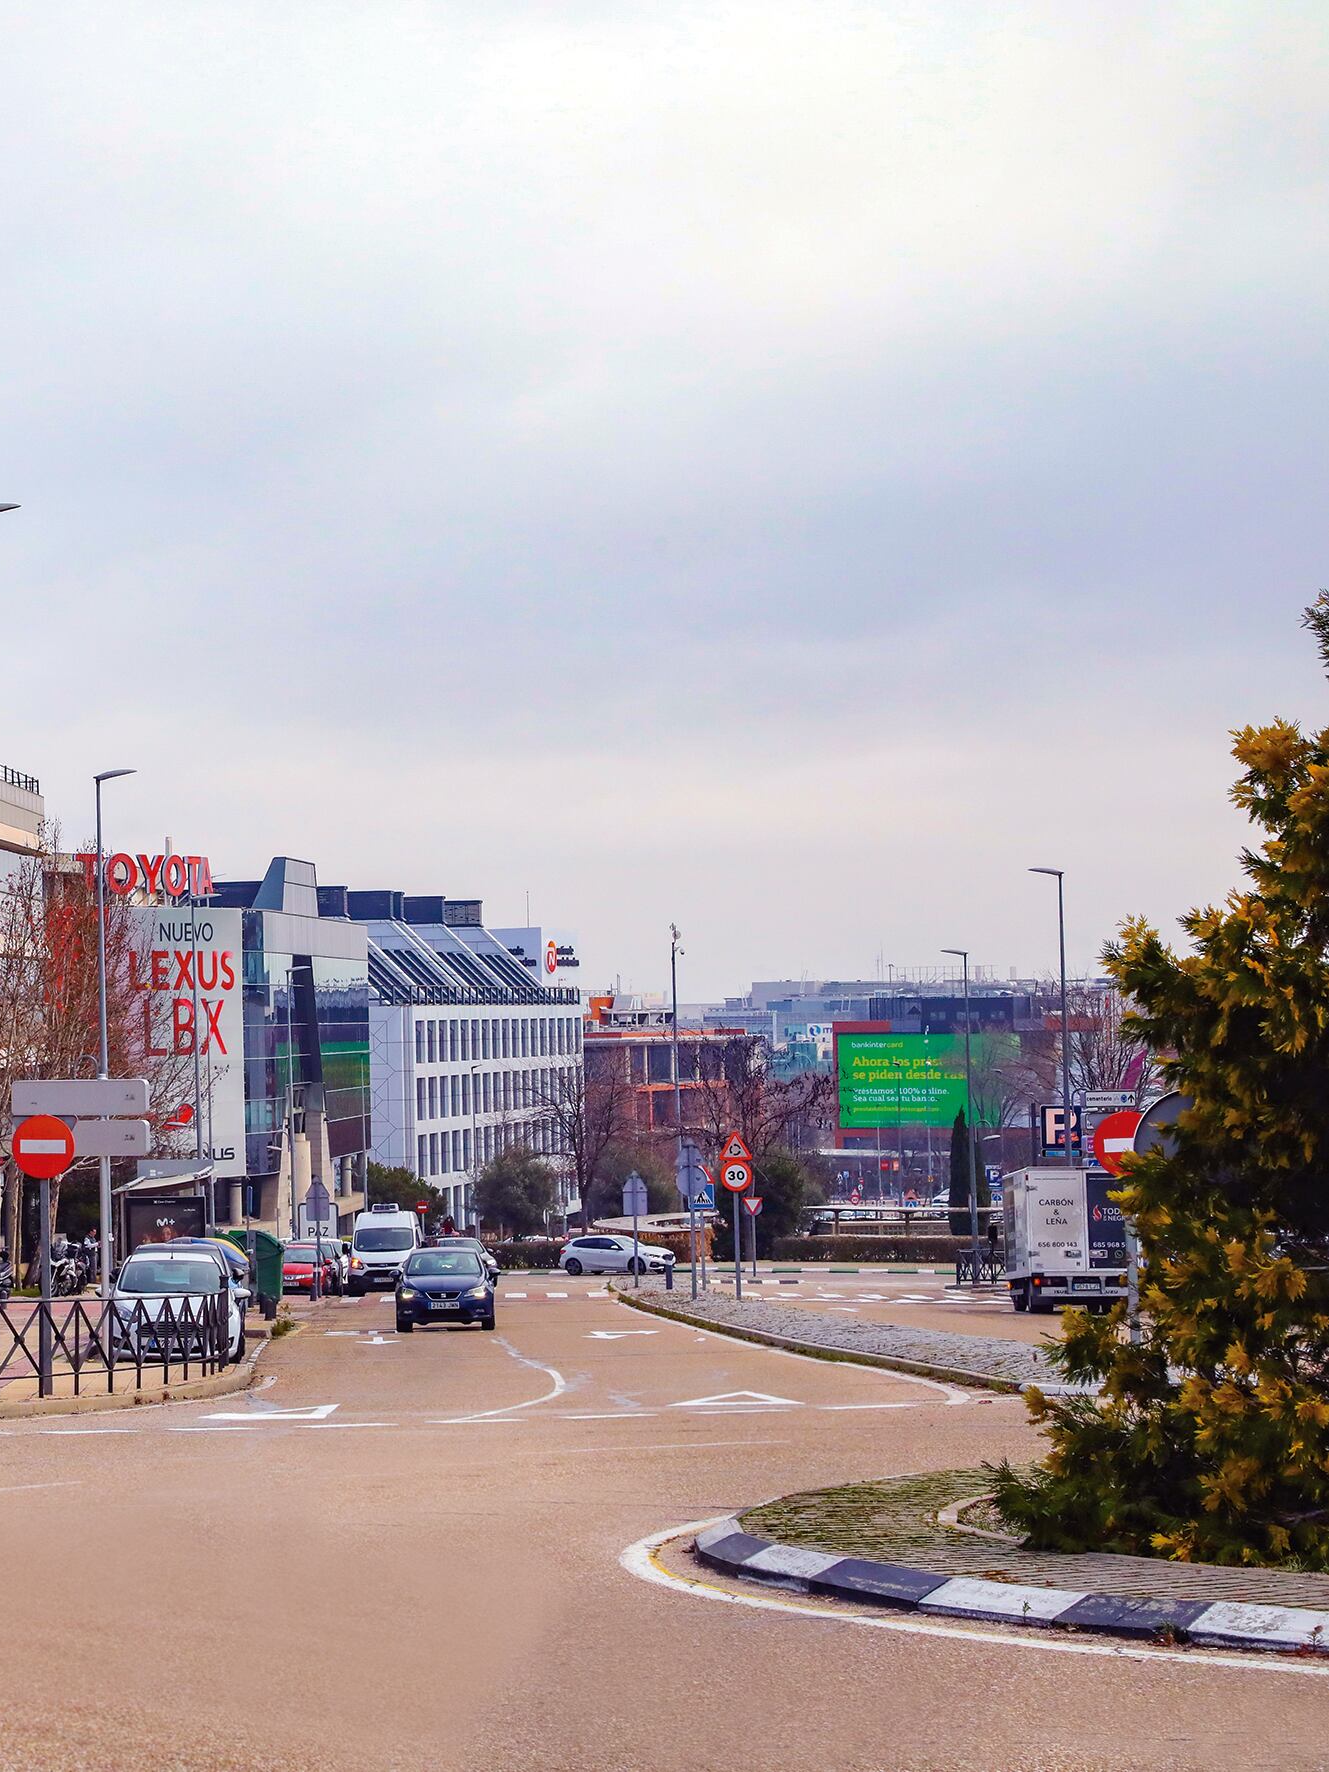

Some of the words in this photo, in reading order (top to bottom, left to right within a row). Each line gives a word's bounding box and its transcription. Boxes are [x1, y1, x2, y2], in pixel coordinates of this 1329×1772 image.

[75, 853, 214, 896] TOYOTA
[159, 922, 214, 942] NUEVO
[128, 950, 235, 991] LEXUS
[143, 998, 227, 1056] LBX
[853, 1056, 890, 1066] Ahora
[893, 1055, 910, 1067] los
[853, 1071, 866, 1080] se
[868, 1069, 903, 1082] piden
[905, 1069, 941, 1080] desde
[1045, 1108, 1078, 1145] P
[727, 1170, 745, 1181] 30
[990, 1170, 1000, 1181] P
[1038, 1198, 1074, 1207] CARBÓN
[1102, 1207, 1123, 1215] TOD
[1045, 1217, 1068, 1225] LEÑA
